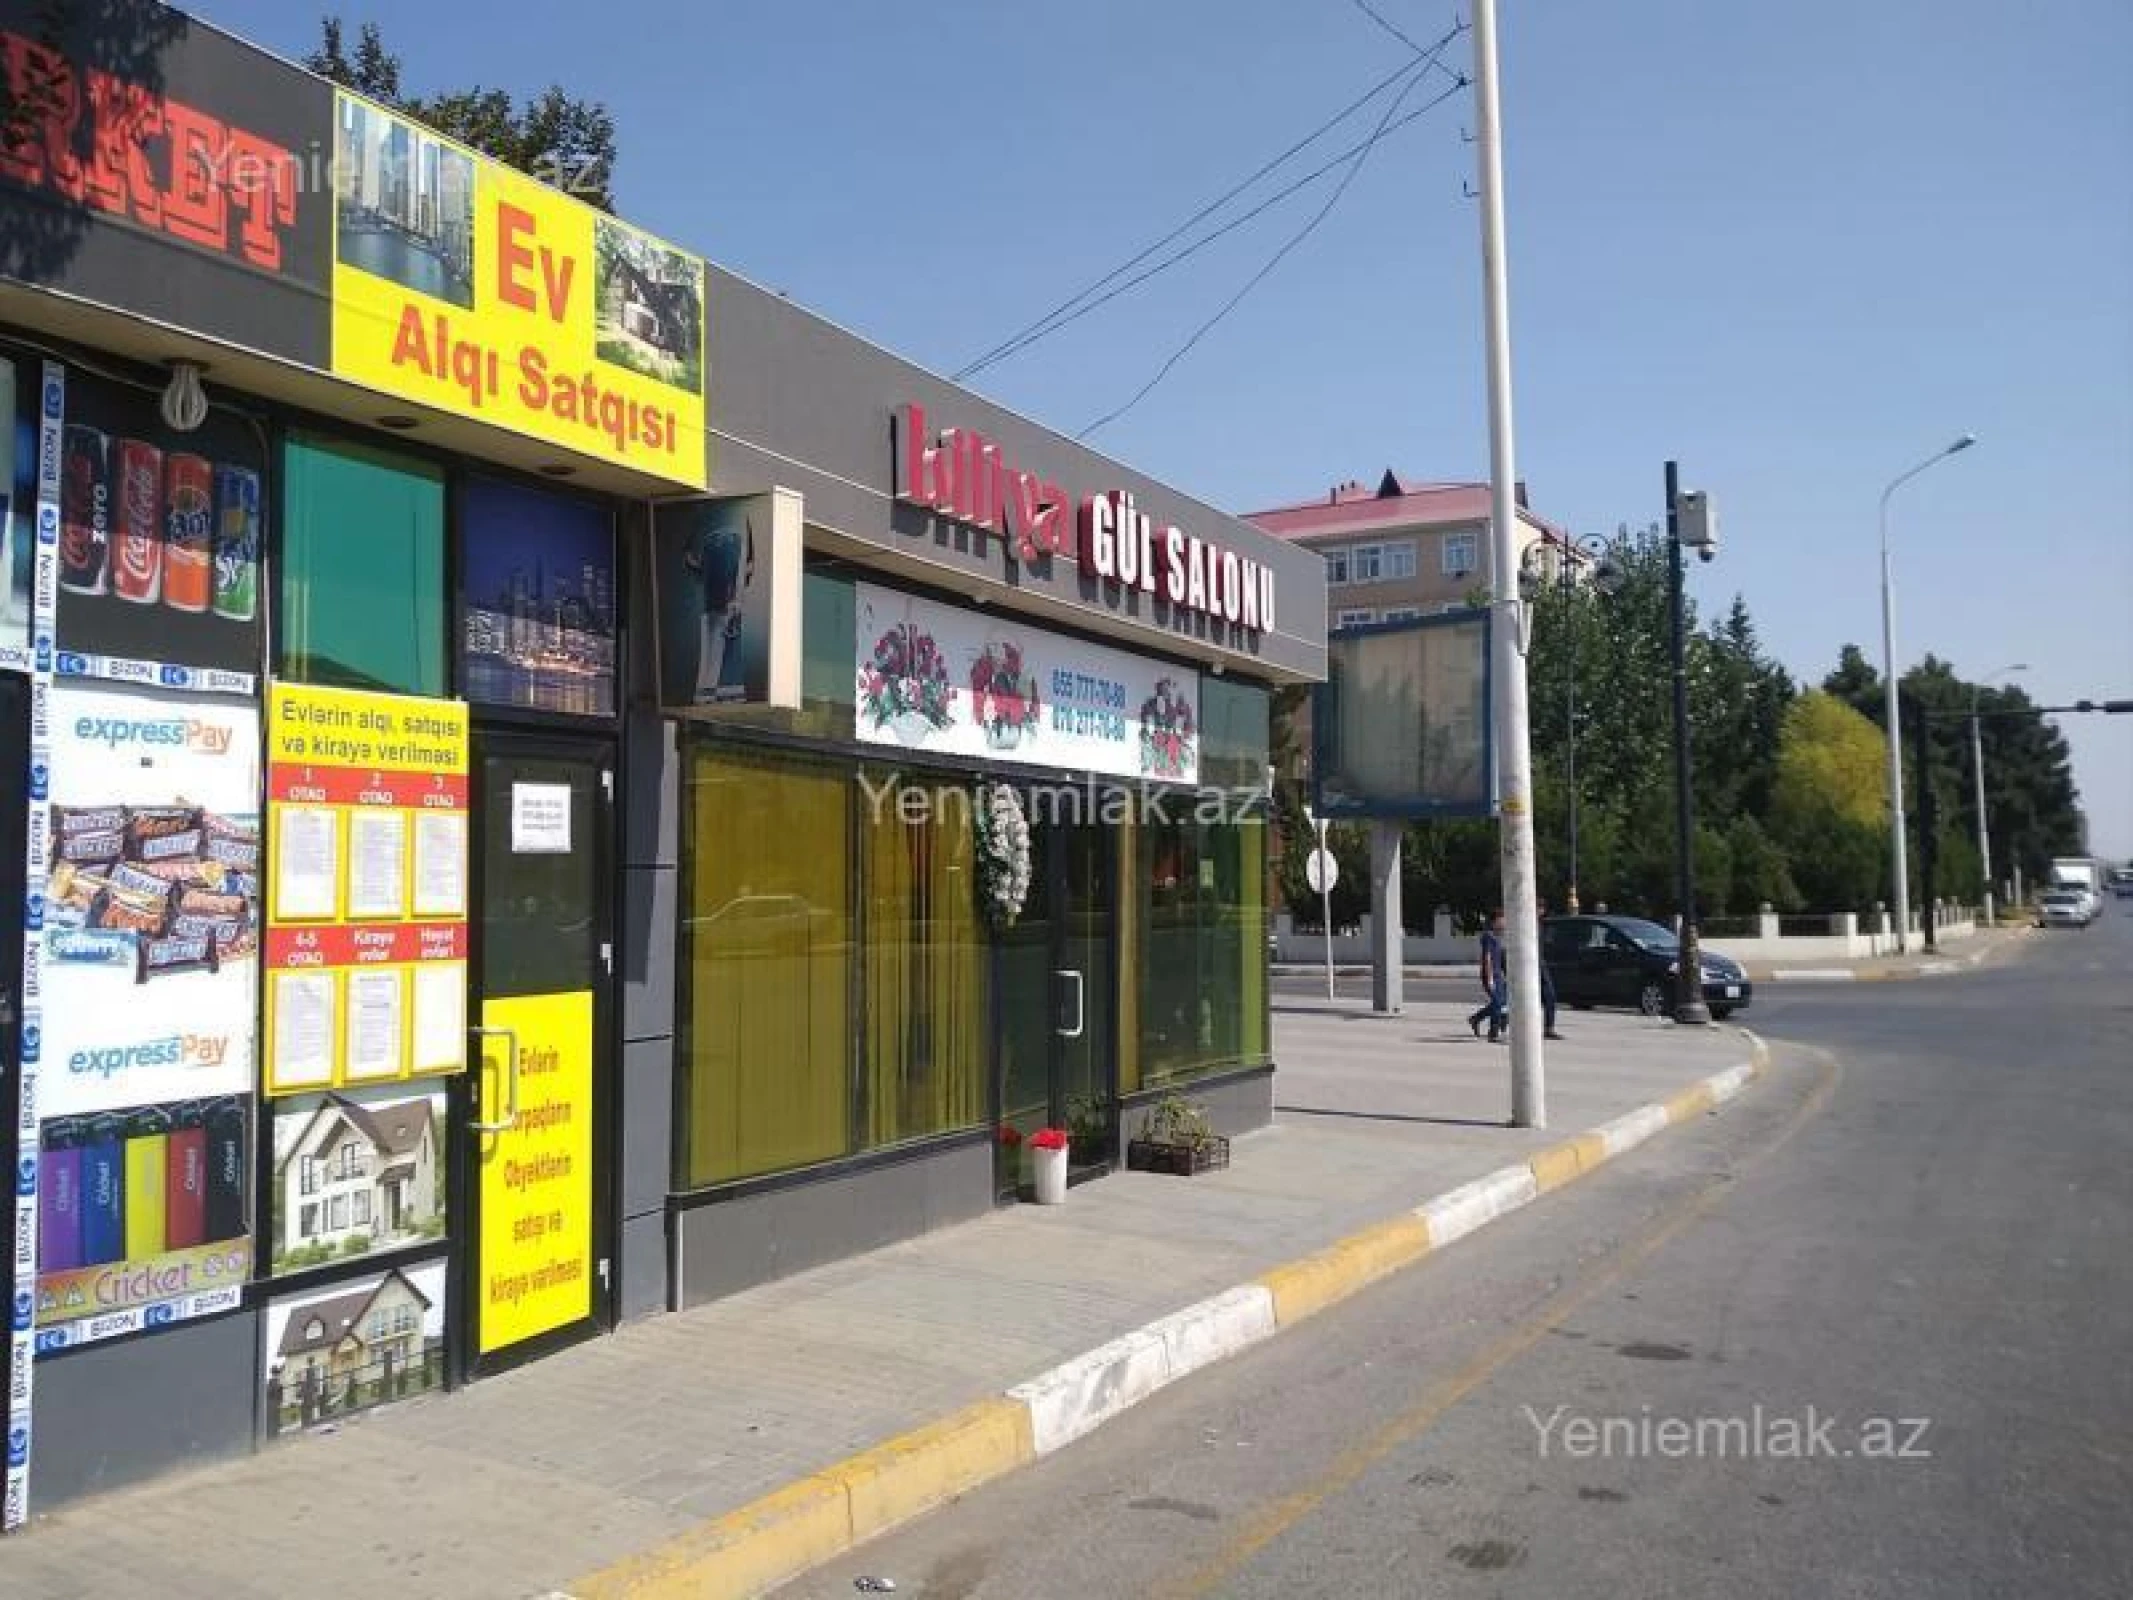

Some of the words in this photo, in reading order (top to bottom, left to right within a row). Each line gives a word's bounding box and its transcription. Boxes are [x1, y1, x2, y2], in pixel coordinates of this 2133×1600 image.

[498, 200, 575, 322] Ev
[392, 304, 498, 407] Alqı
[519, 345, 676, 453] Satqısı
[92, 482, 107, 545] zero
[1089, 490, 1156, 593] GÜL
[1166, 526, 1276, 633] SALONU
[73, 715, 233, 755] expressPay
[281, 699, 353, 727] Evlərin
[281, 736, 306, 754] və
[311, 735, 372, 764] kirayə
[68, 1033, 230, 1079] expressPay
[95, 1263, 194, 1305] Cricket
